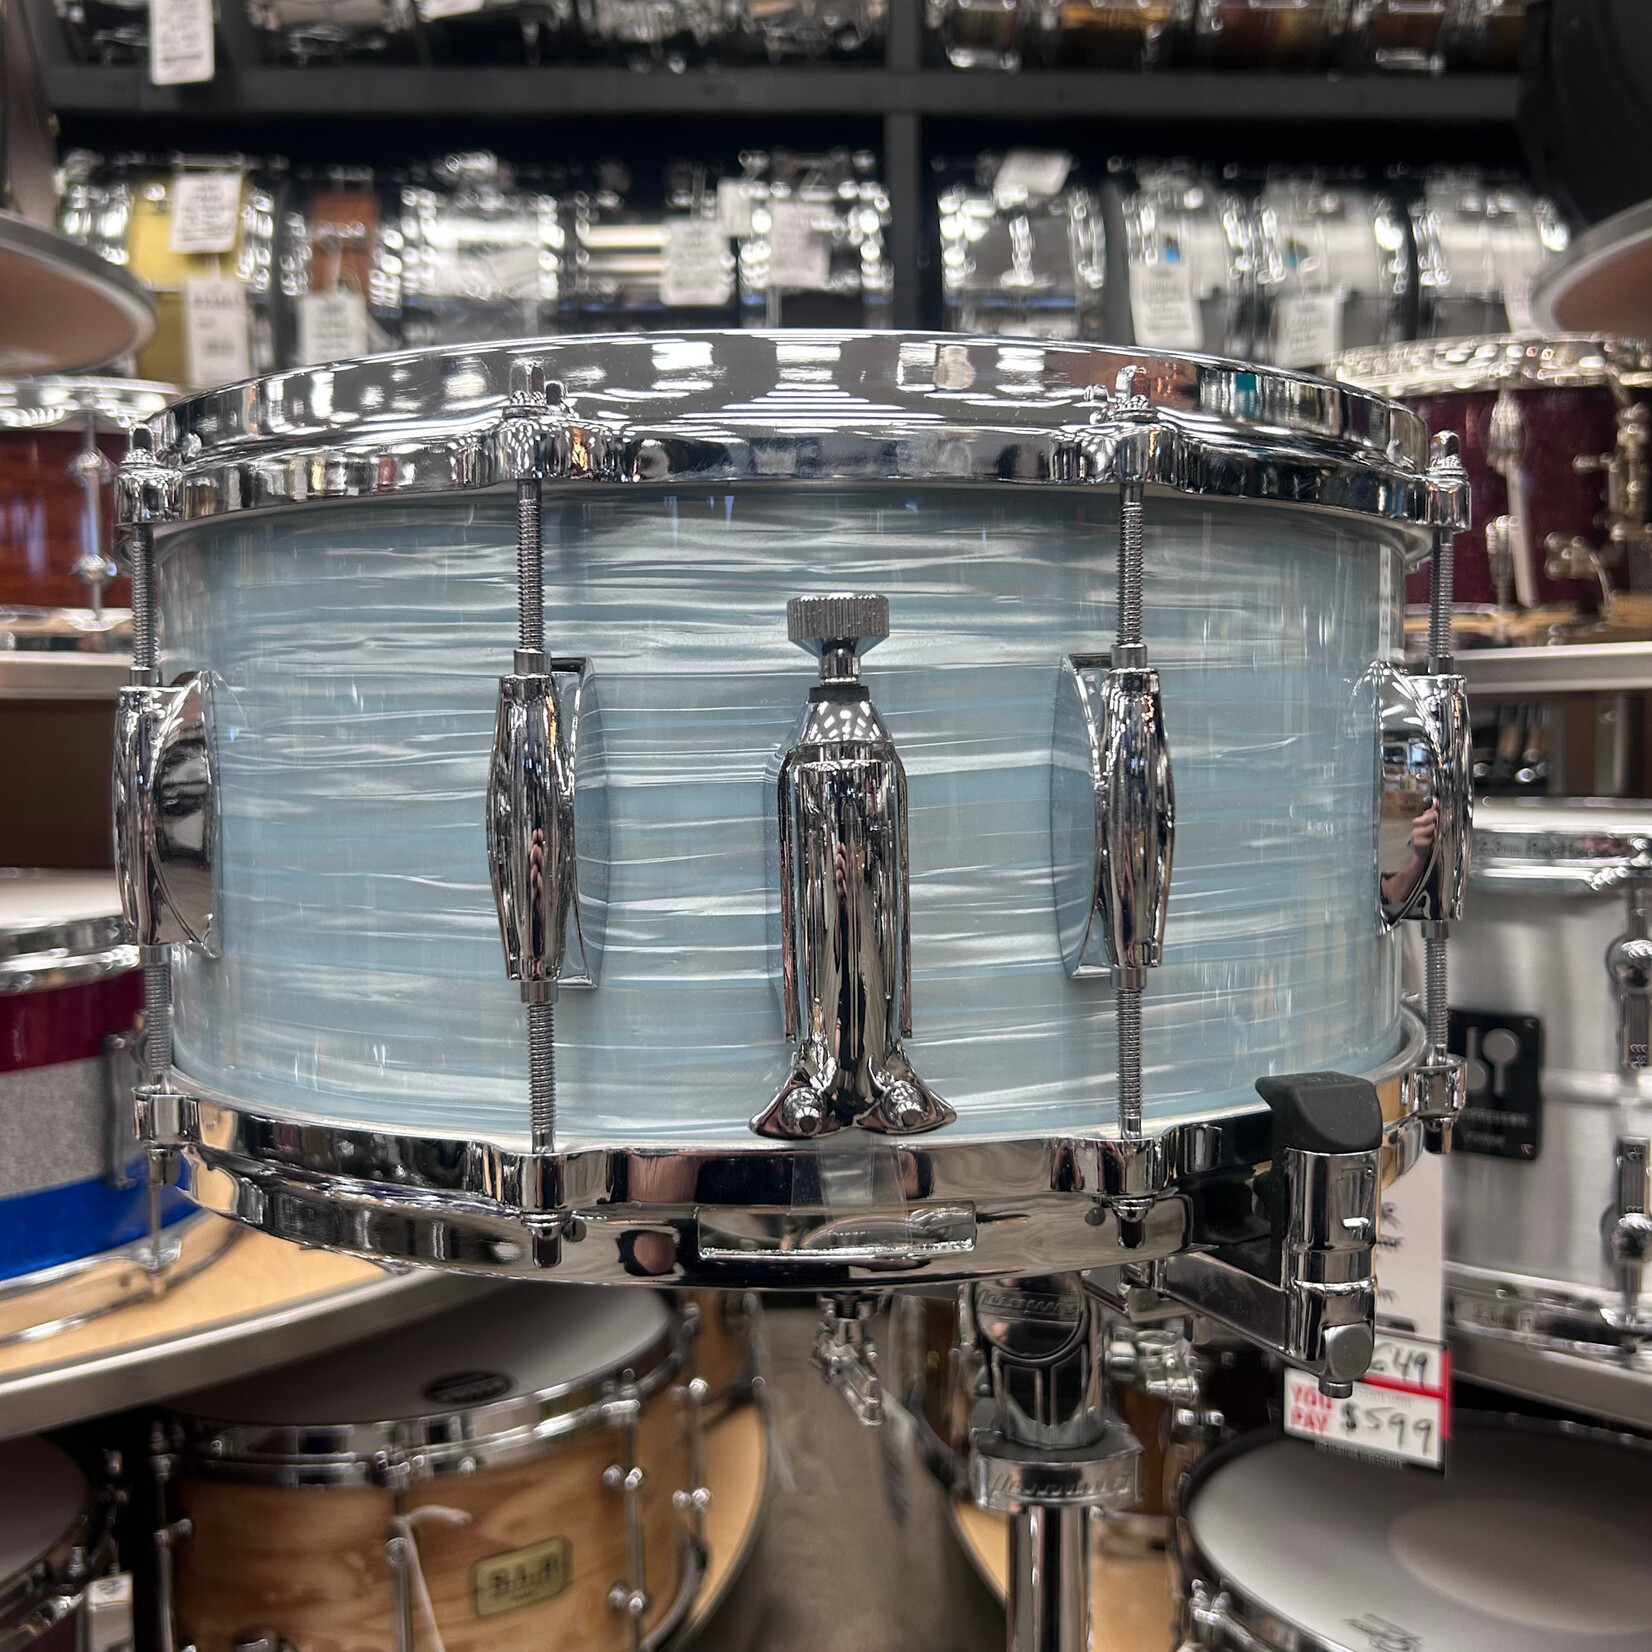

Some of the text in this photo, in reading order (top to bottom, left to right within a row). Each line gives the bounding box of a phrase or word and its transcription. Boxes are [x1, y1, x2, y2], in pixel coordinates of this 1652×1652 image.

[1291, 1384, 1333, 1411] YOU
[1290, 1408, 1330, 1433] PAY
[1340, 1401, 1433, 1455] $599
